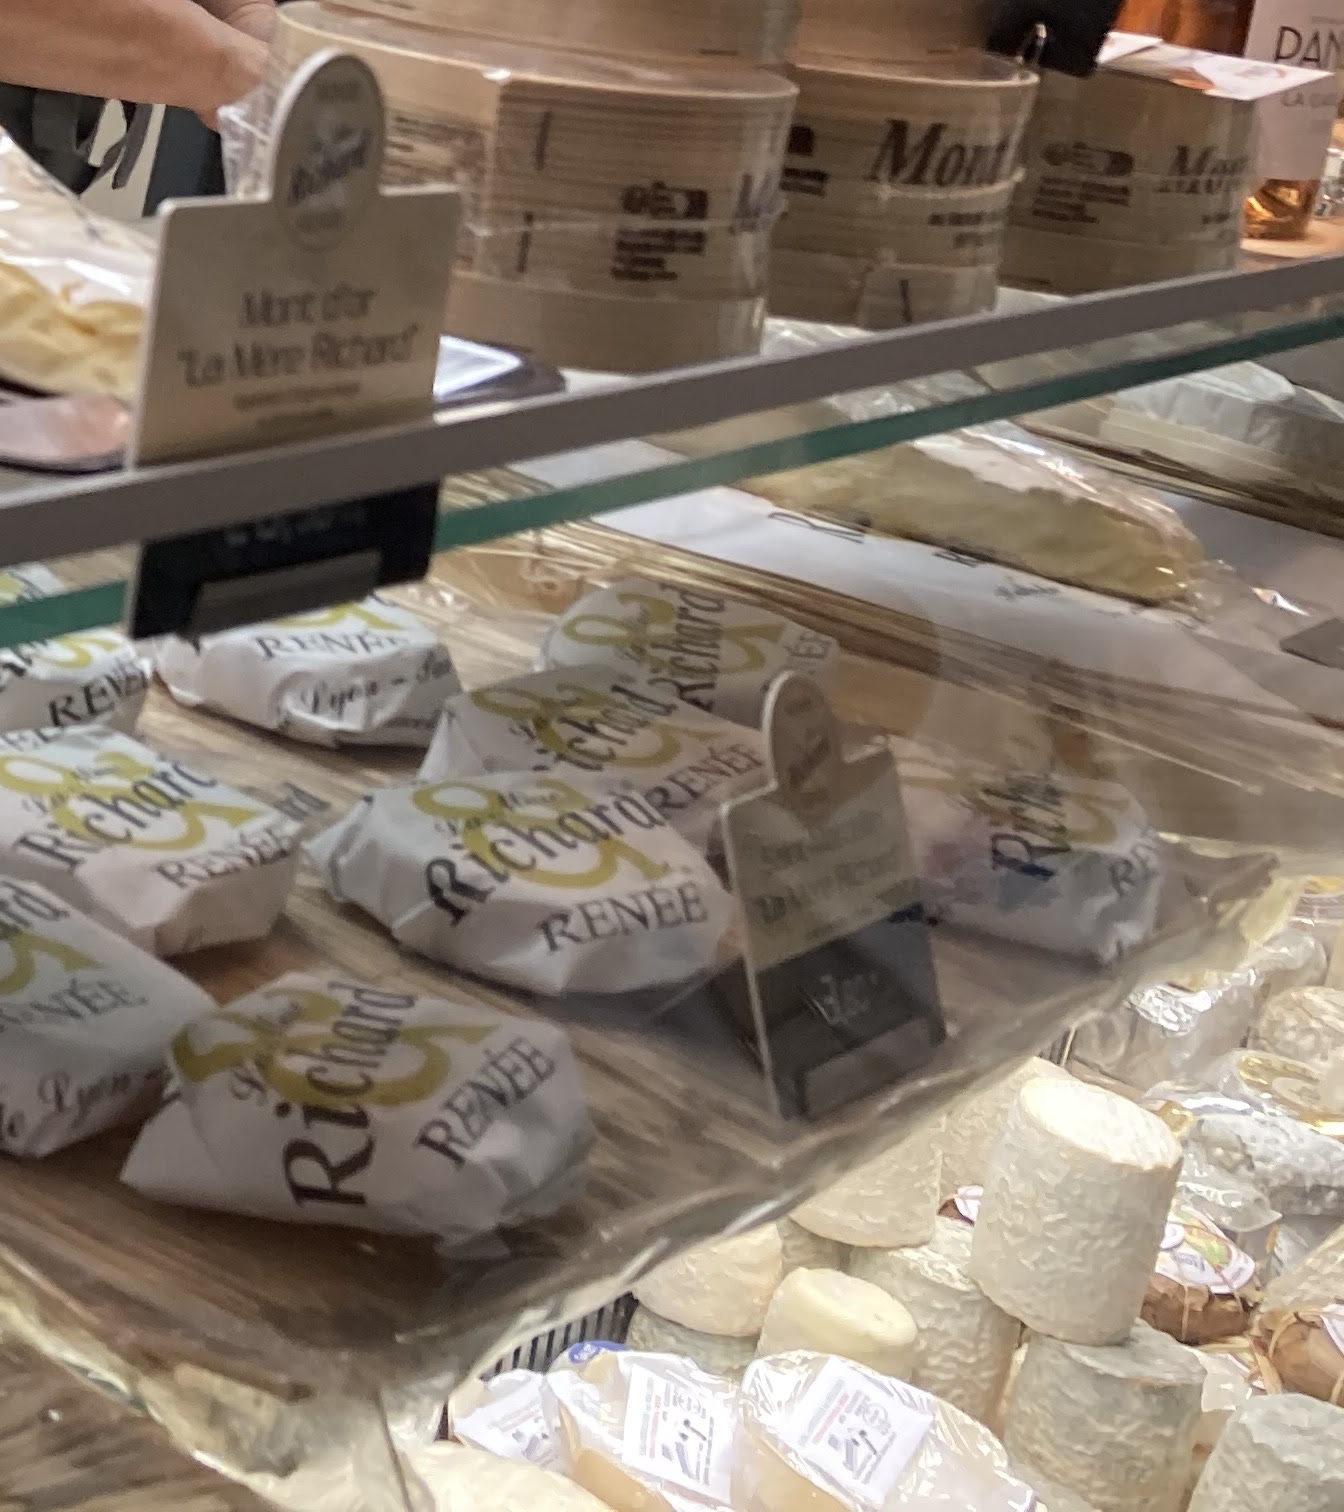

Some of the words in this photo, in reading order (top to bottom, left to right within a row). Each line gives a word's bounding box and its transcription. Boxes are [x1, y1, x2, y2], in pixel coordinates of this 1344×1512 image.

[532, 683, 679, 773] ichard
[426, 790, 668, 928] Richard
[537, 874, 710, 954] RENÉE
[274, 980, 418, 1210] Richard
[415, 1034, 558, 1171] RENÉE
